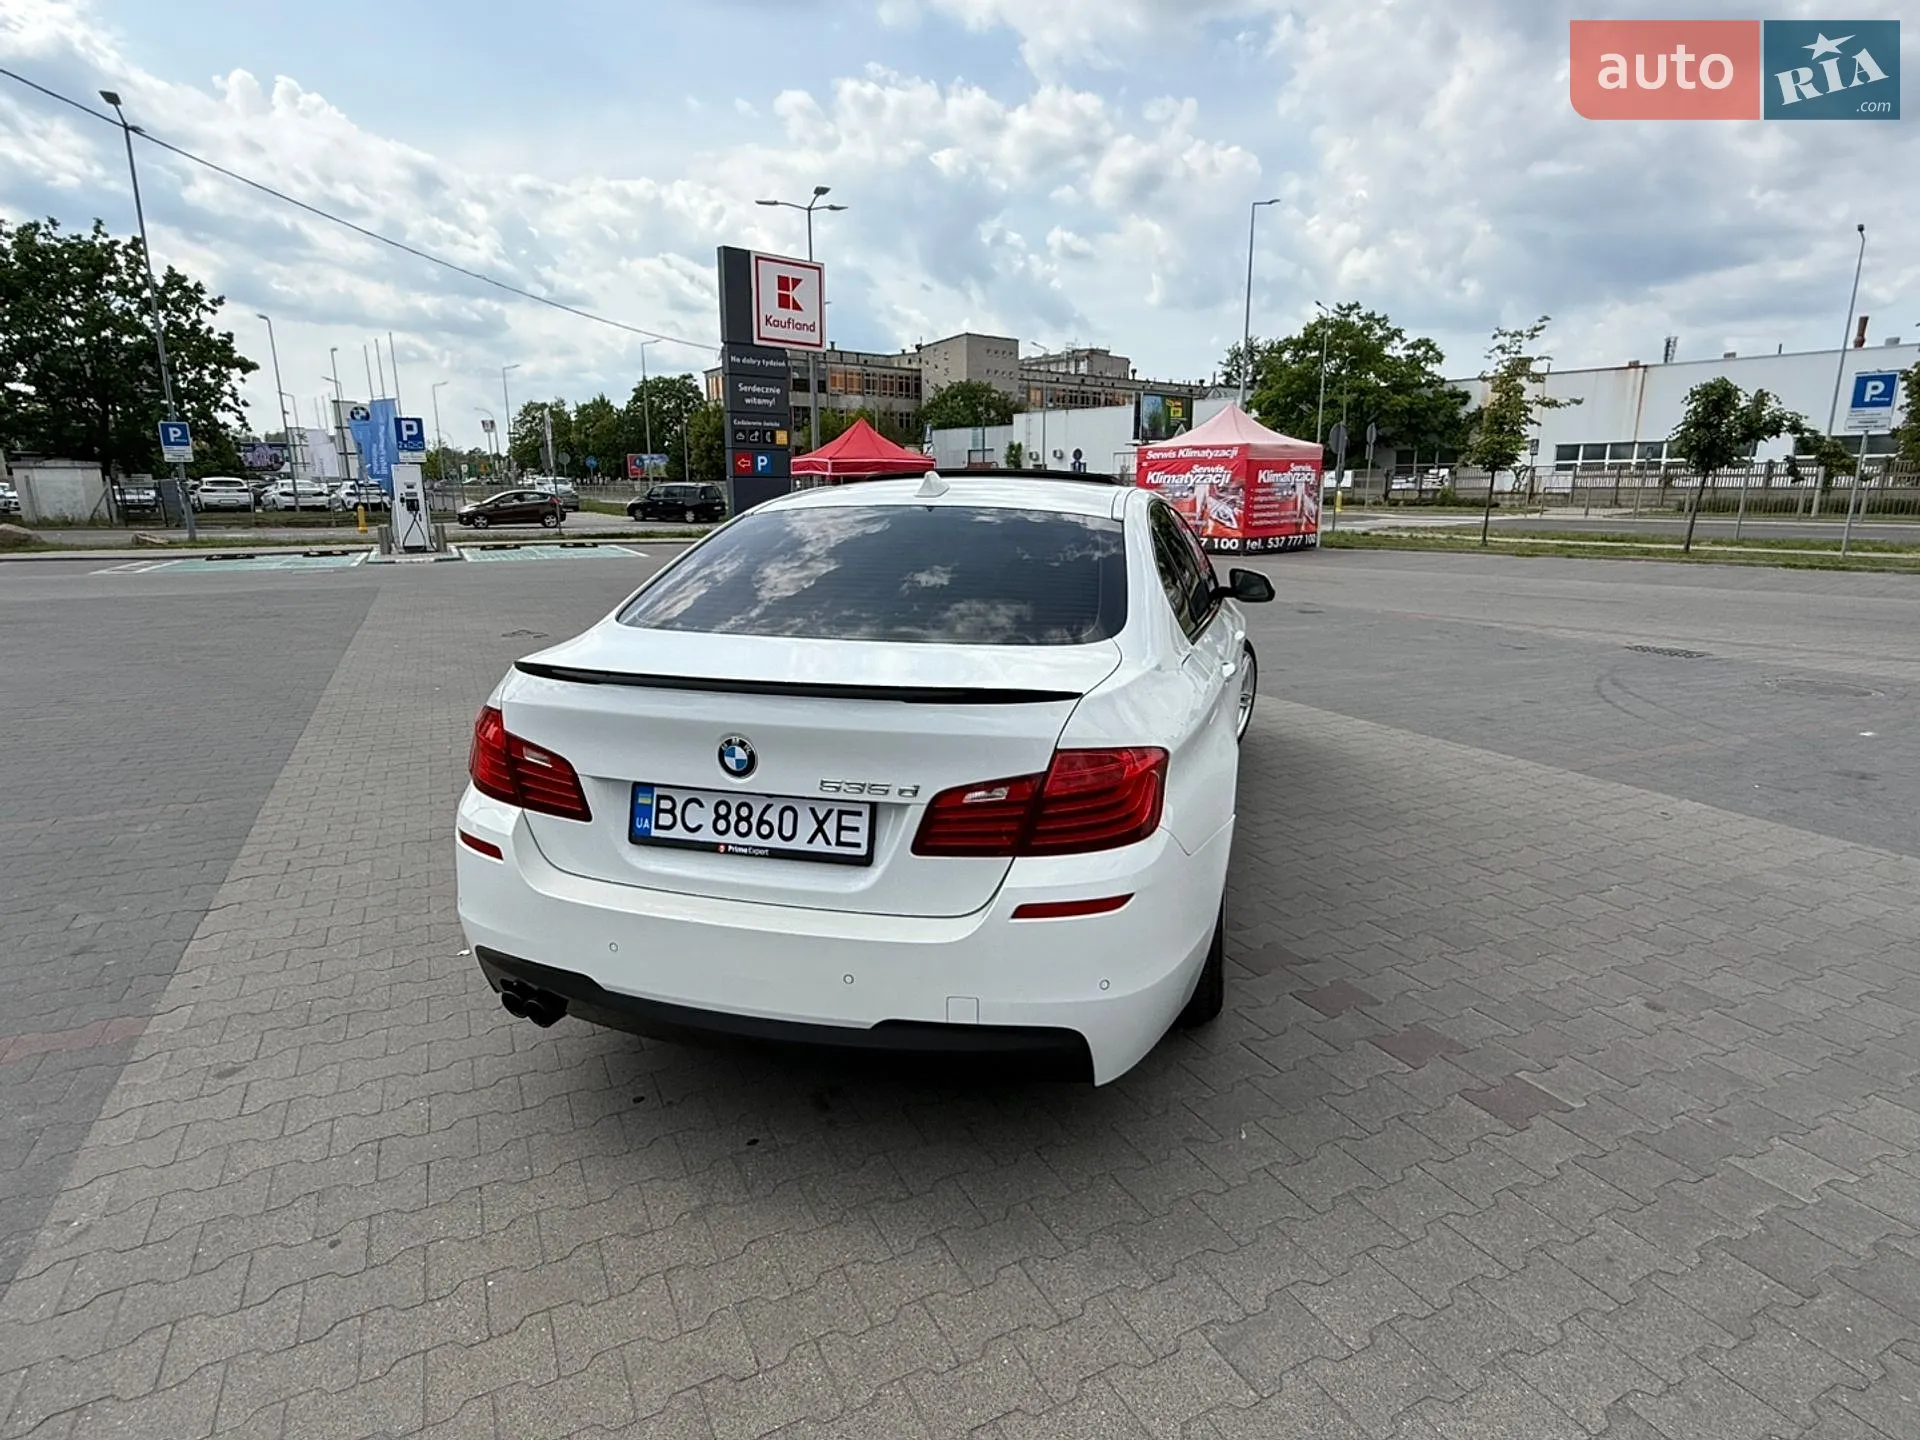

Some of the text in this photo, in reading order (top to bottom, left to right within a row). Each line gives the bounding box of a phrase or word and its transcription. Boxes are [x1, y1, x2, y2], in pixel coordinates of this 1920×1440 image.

[765, 314, 816, 333] Kaufland
[742, 357, 761, 367] dobry
[738, 382, 781, 394] Serdecznie
[744, 396, 776, 408] witamy!
[1146, 447, 1239, 460] Serwis Klimatyzacji
[1145, 470, 1232, 487] Klimatyzacji
[1213, 538, 1239, 550] 100
[1246, 539, 1264, 551] tel.
[1266, 535, 1285, 548] 537
[1287, 533, 1304, 546] 777
[635, 817, 650, 830] UA
[654, 794, 863, 849] BC 8860 XE
